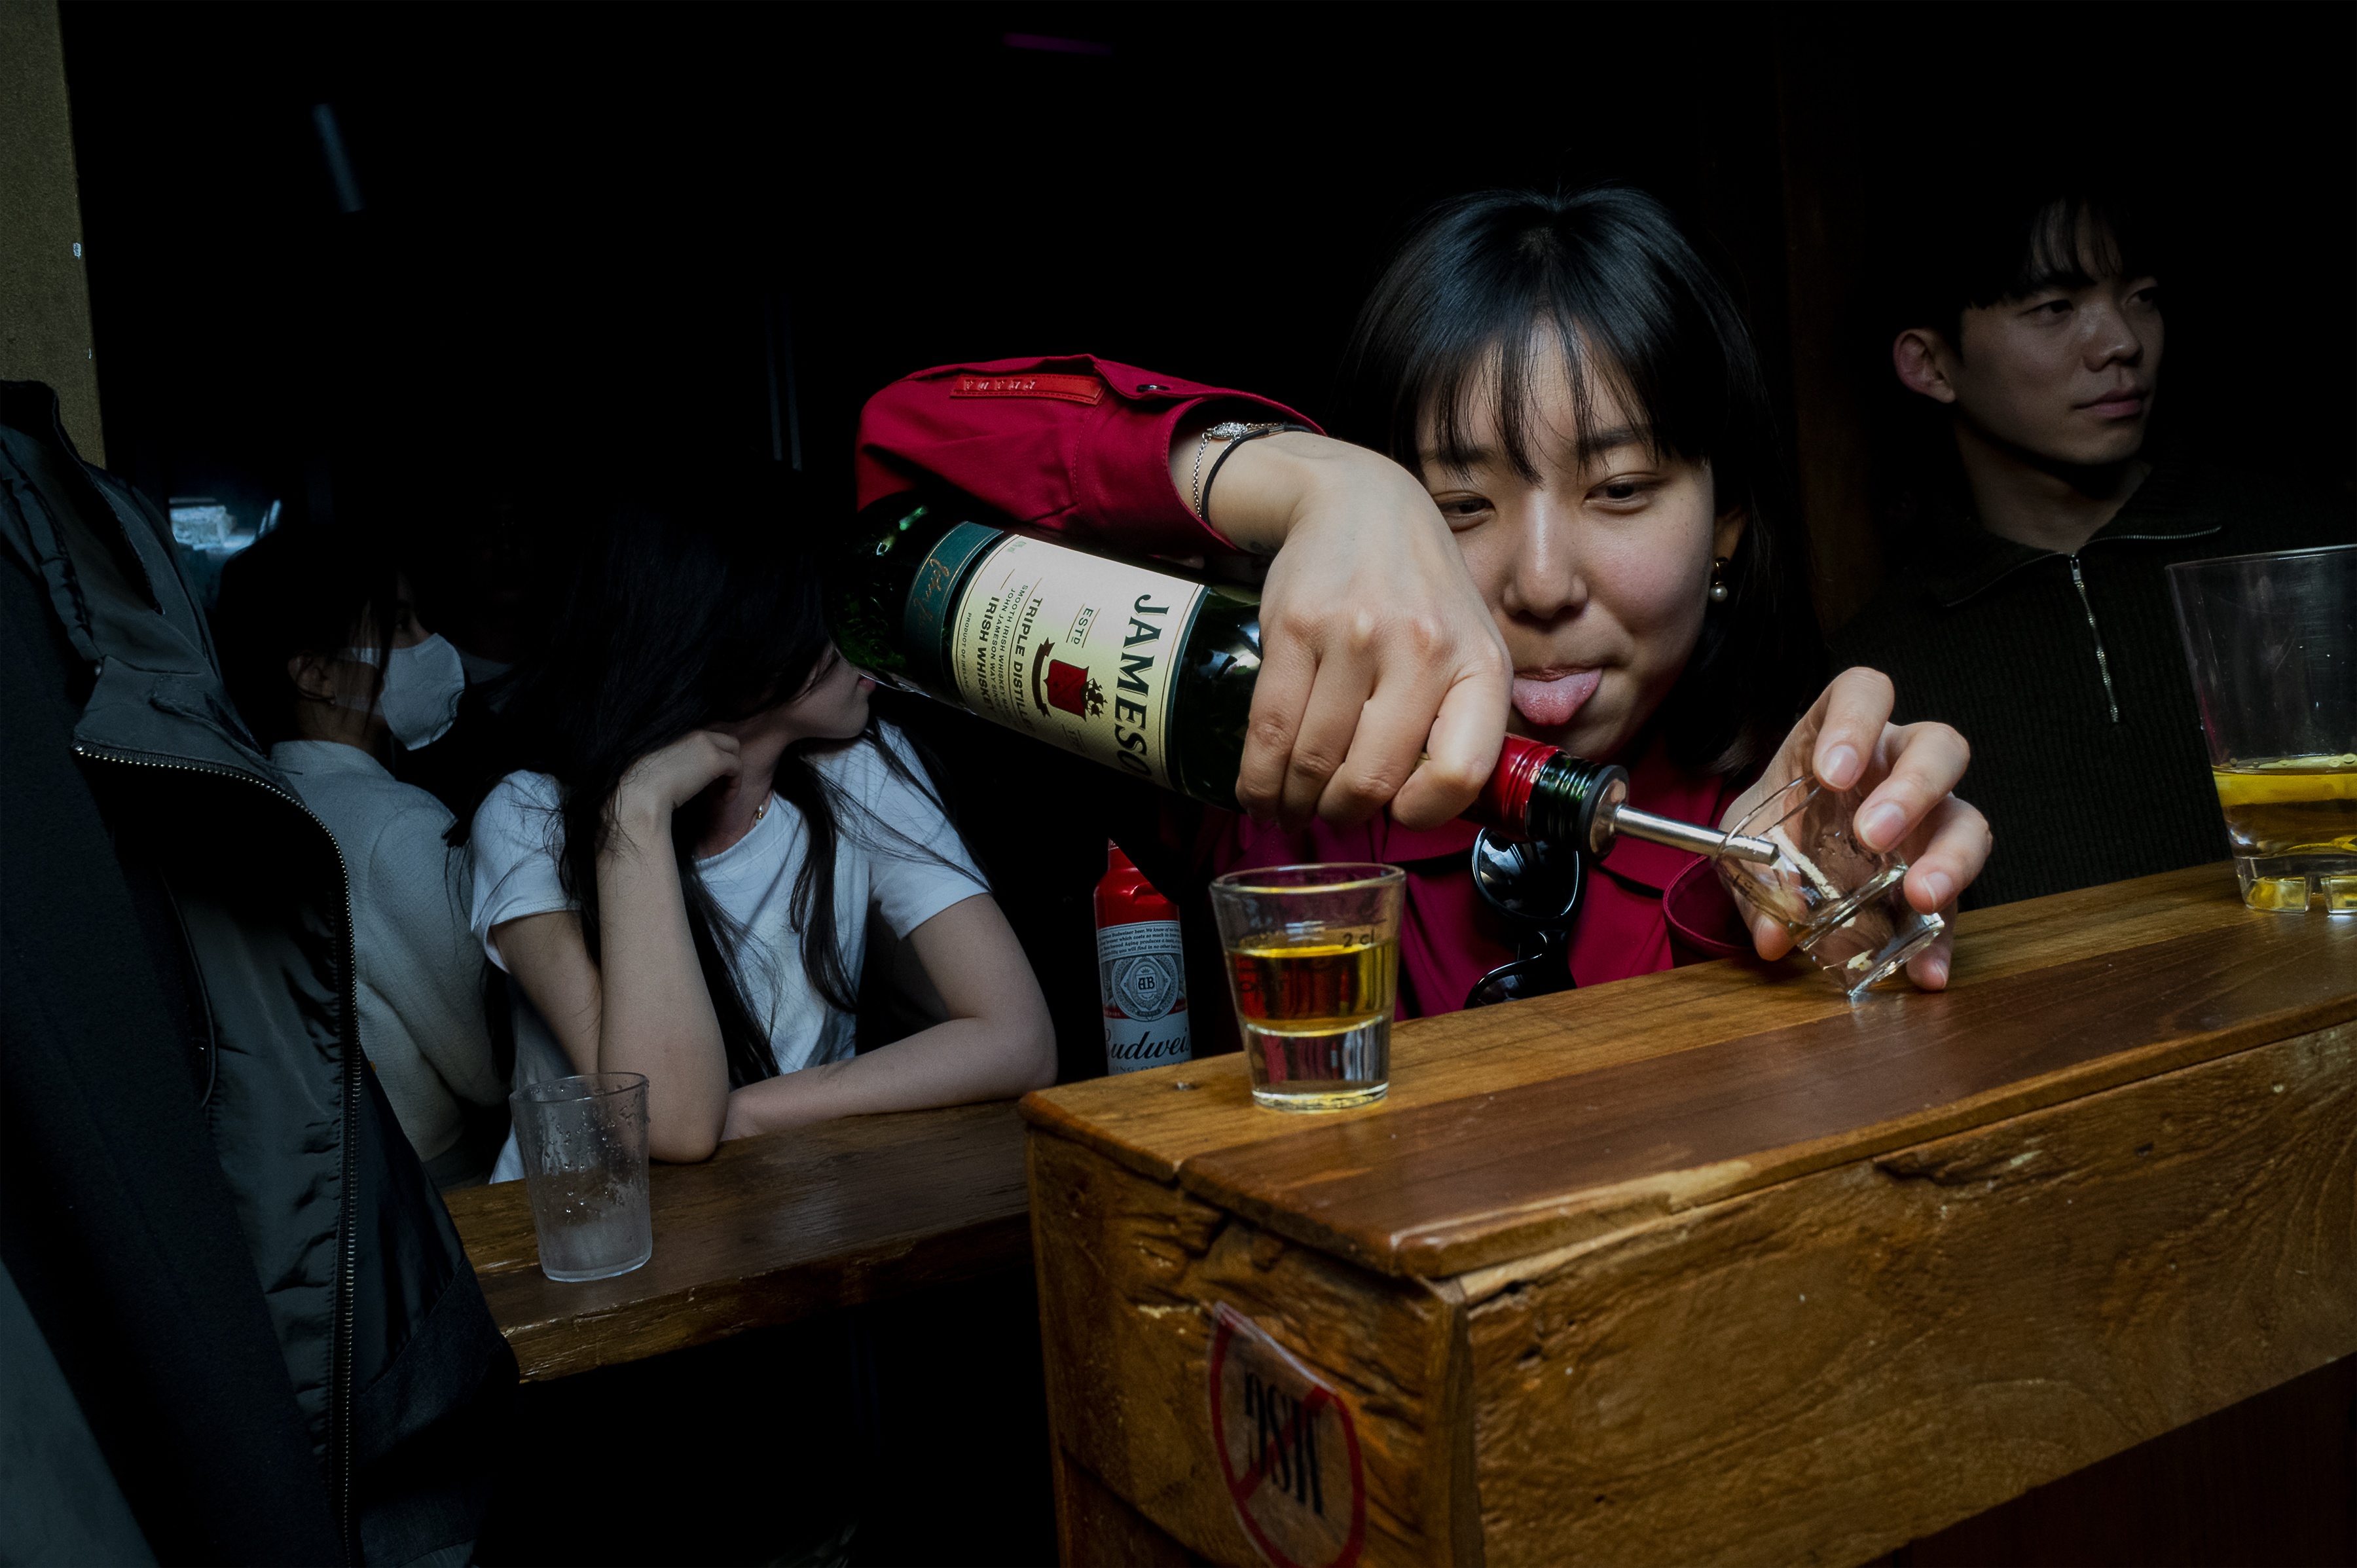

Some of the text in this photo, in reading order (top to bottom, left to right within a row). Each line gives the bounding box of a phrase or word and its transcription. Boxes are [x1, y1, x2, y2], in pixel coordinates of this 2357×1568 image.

[964, 378, 1037, 391] PRADA
[1002, 588, 1015, 611] JOHN
[1007, 585, 1029, 623] SMOOTH
[991, 615, 1004, 659] JAMESON
[1000, 625, 1010, 651] IRISH
[1015, 598, 1043, 657] TRIPLE
[960, 612, 972, 689] PRODUCT OF IRELAND
[976, 596, 1000, 712] IRISH WHISKEY
[1013, 661, 1036, 732] DISTILLED
[1114, 593, 1171, 780] JAMESO
[1343, 928, 1375, 947] 2 cl
[1138, 976, 1155, 990] AB
